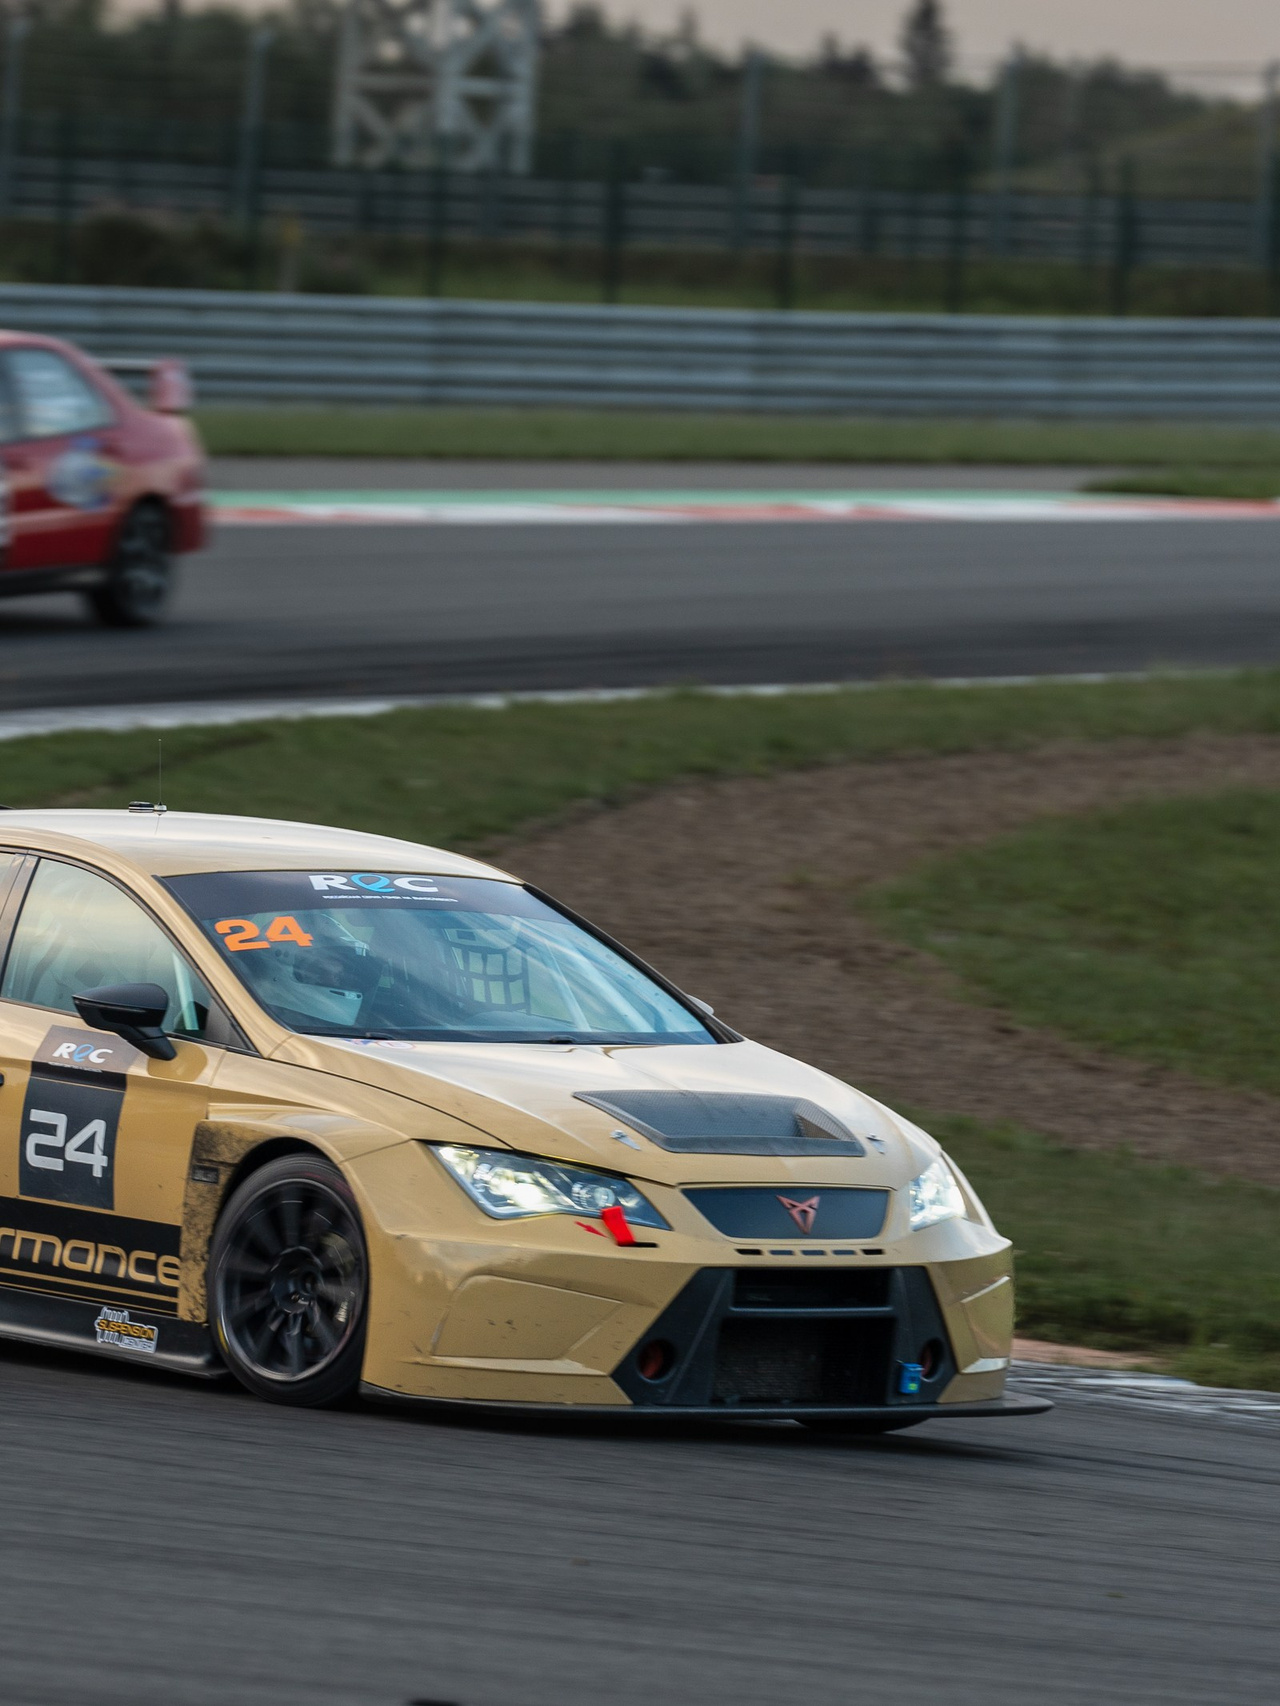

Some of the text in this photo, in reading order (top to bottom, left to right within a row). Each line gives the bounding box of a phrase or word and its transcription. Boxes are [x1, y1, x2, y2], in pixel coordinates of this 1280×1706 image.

[214, 916, 313, 952] 24
[25, 1108, 108, 1178] 24
[98, 1319, 155, 1340] SUSPENSION
